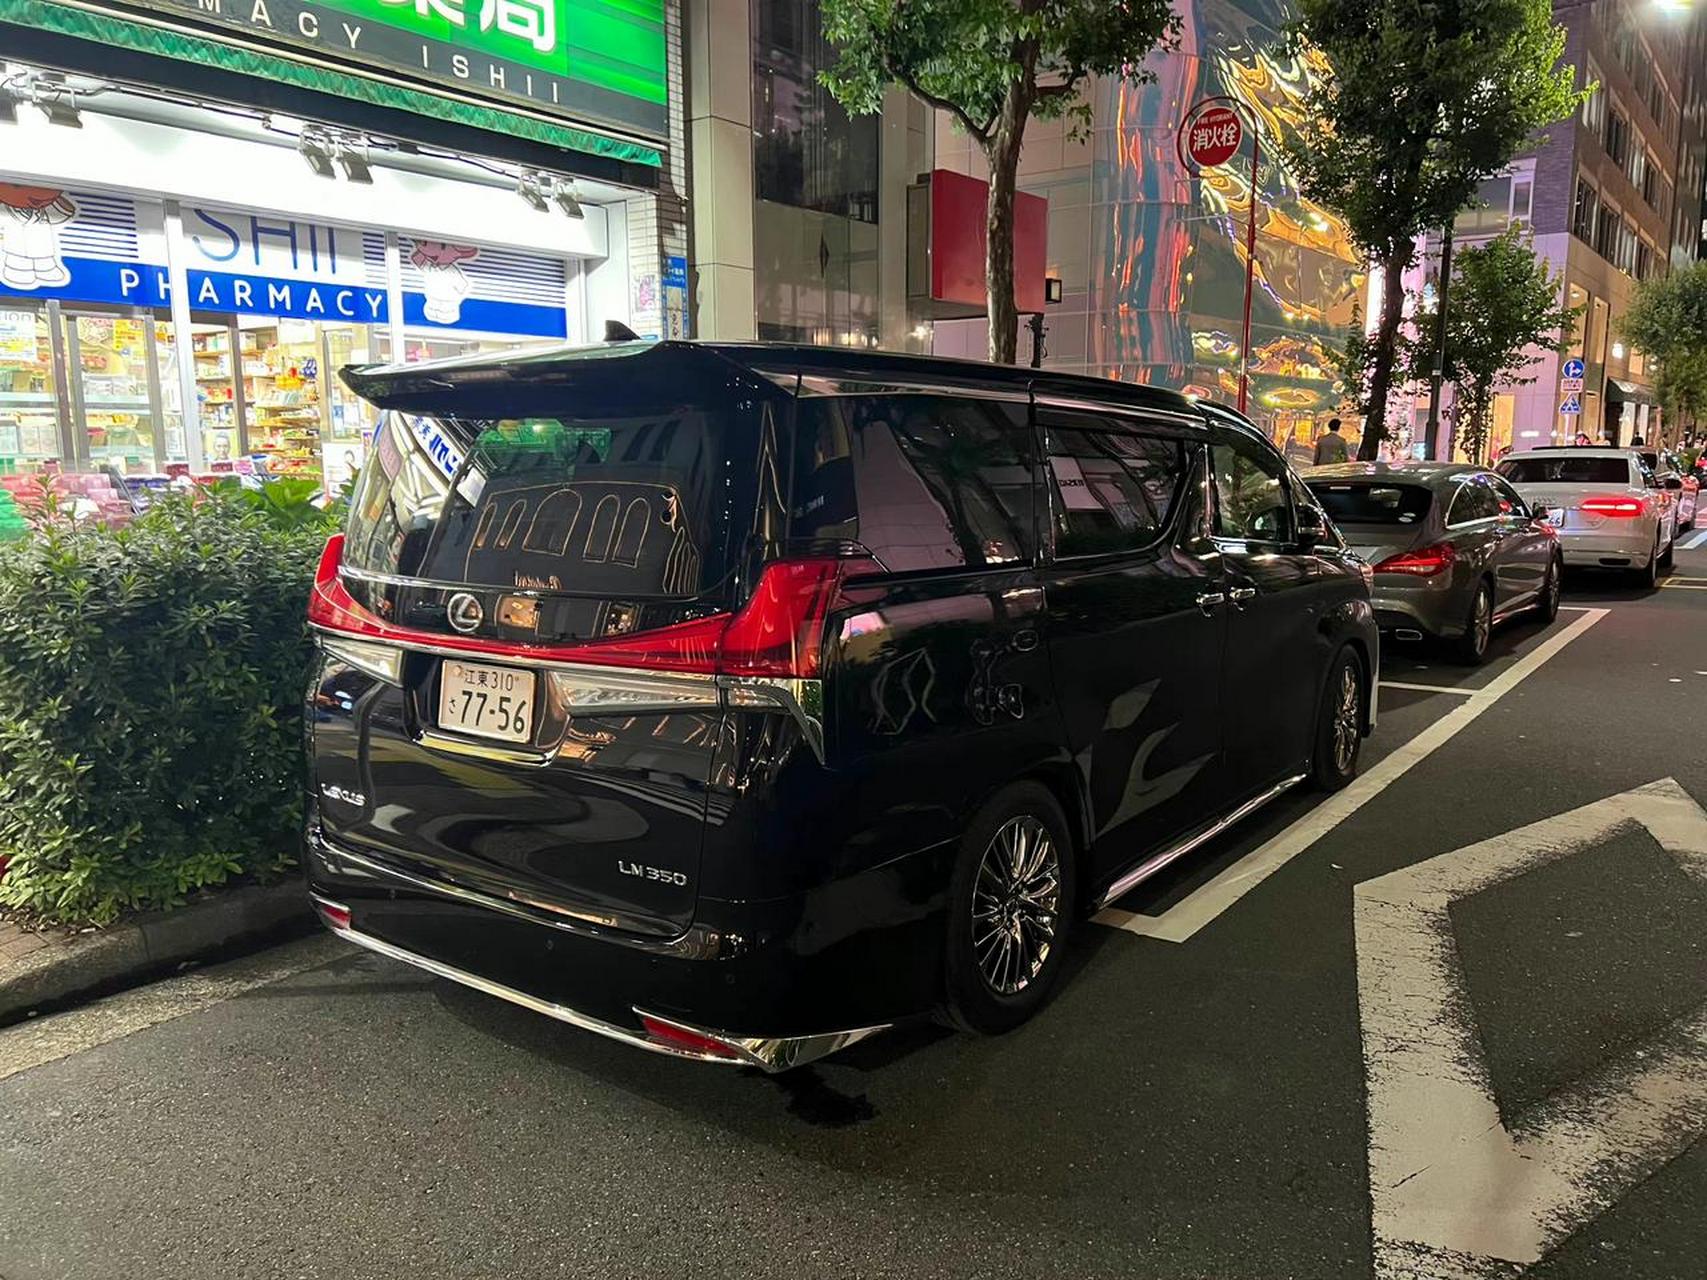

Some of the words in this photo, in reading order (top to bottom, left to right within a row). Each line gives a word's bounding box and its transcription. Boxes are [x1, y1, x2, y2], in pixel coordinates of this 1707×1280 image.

[422, 44, 559, 104] ISHII
[1193, 123, 1237, 151] 消火栓
[119, 268, 383, 318] PHARMACY
[461, 690, 527, 734] 77-56
[618, 860, 644, 877] LM
[646, 866, 687, 887] 350
